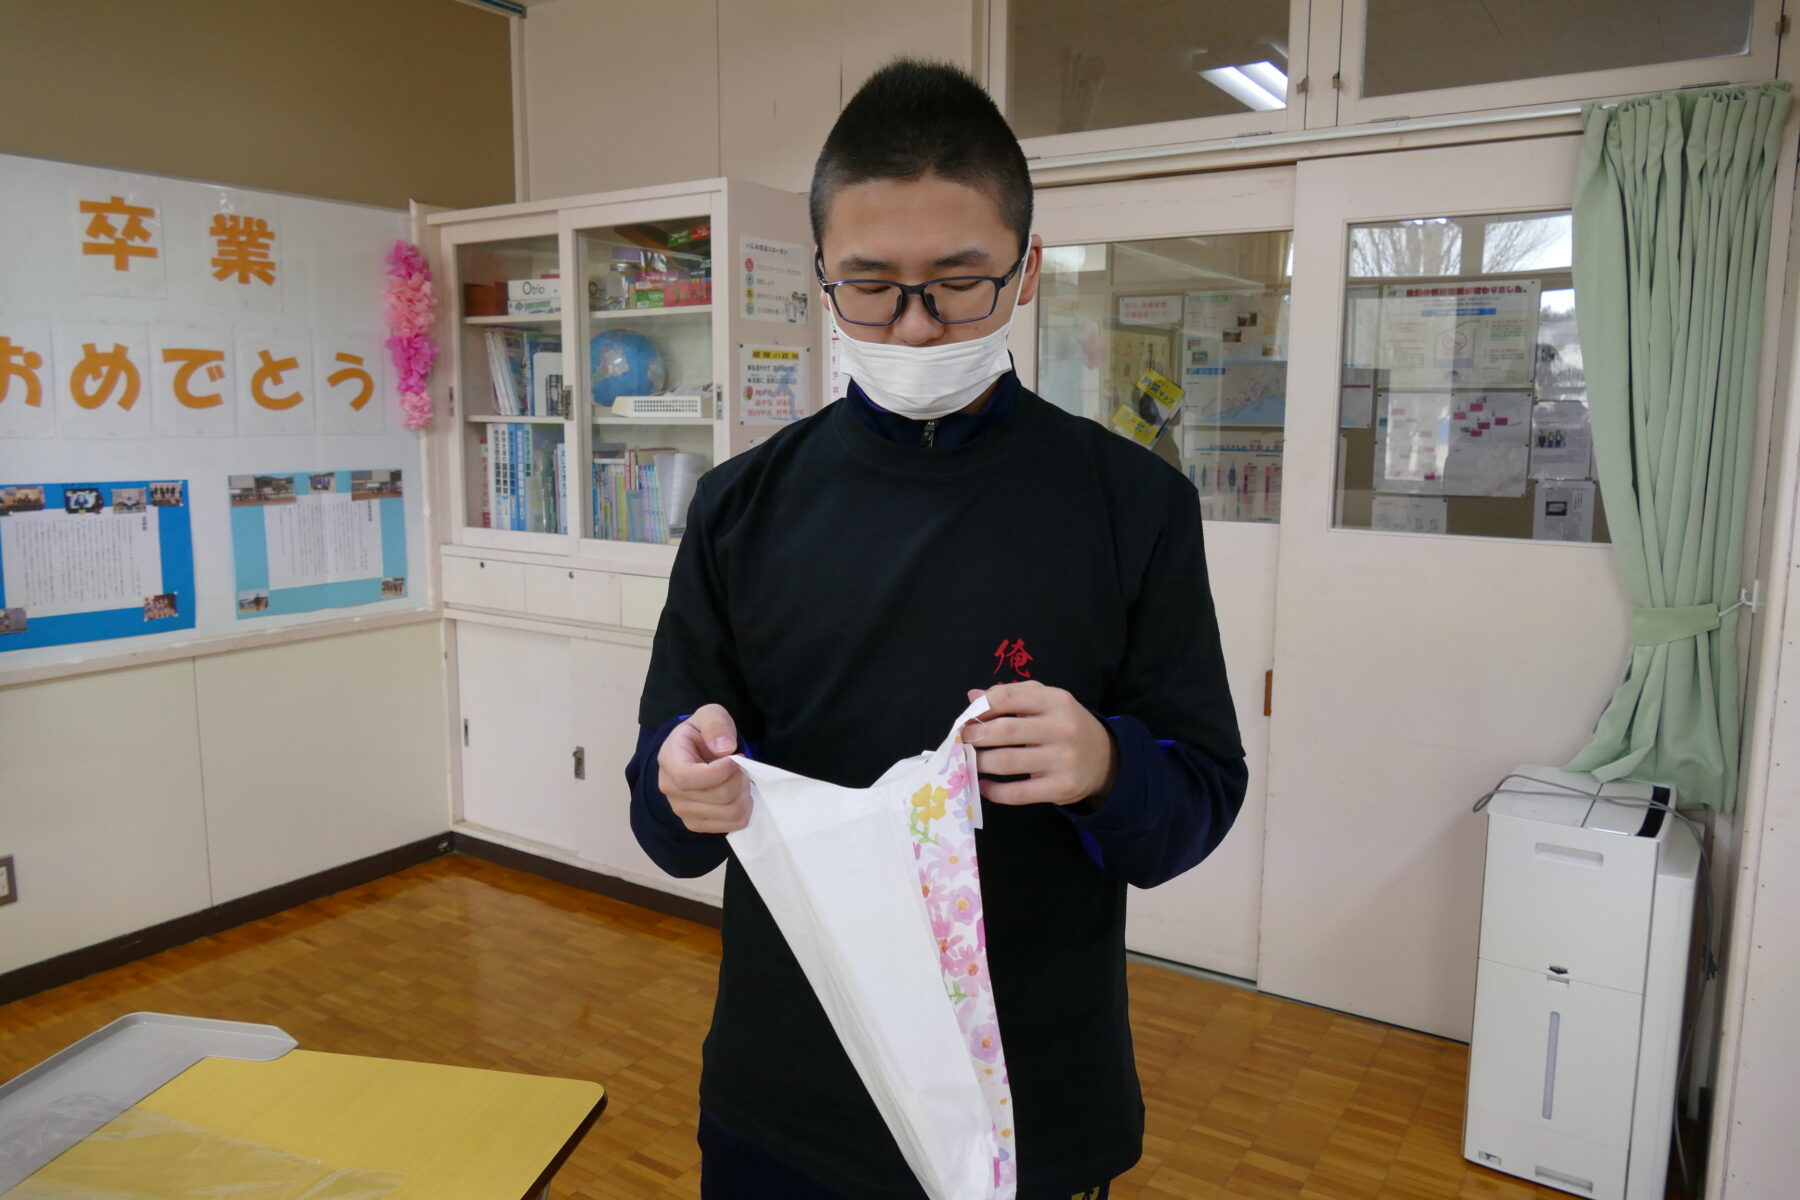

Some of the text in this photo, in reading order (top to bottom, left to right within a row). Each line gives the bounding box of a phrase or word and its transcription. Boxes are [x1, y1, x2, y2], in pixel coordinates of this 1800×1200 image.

[79, 196, 276, 287] 卒業
[522, 281, 545, 295] Otrio
[0, 335, 374, 412] おめでとう
[993, 638, 1034, 679] 俺
